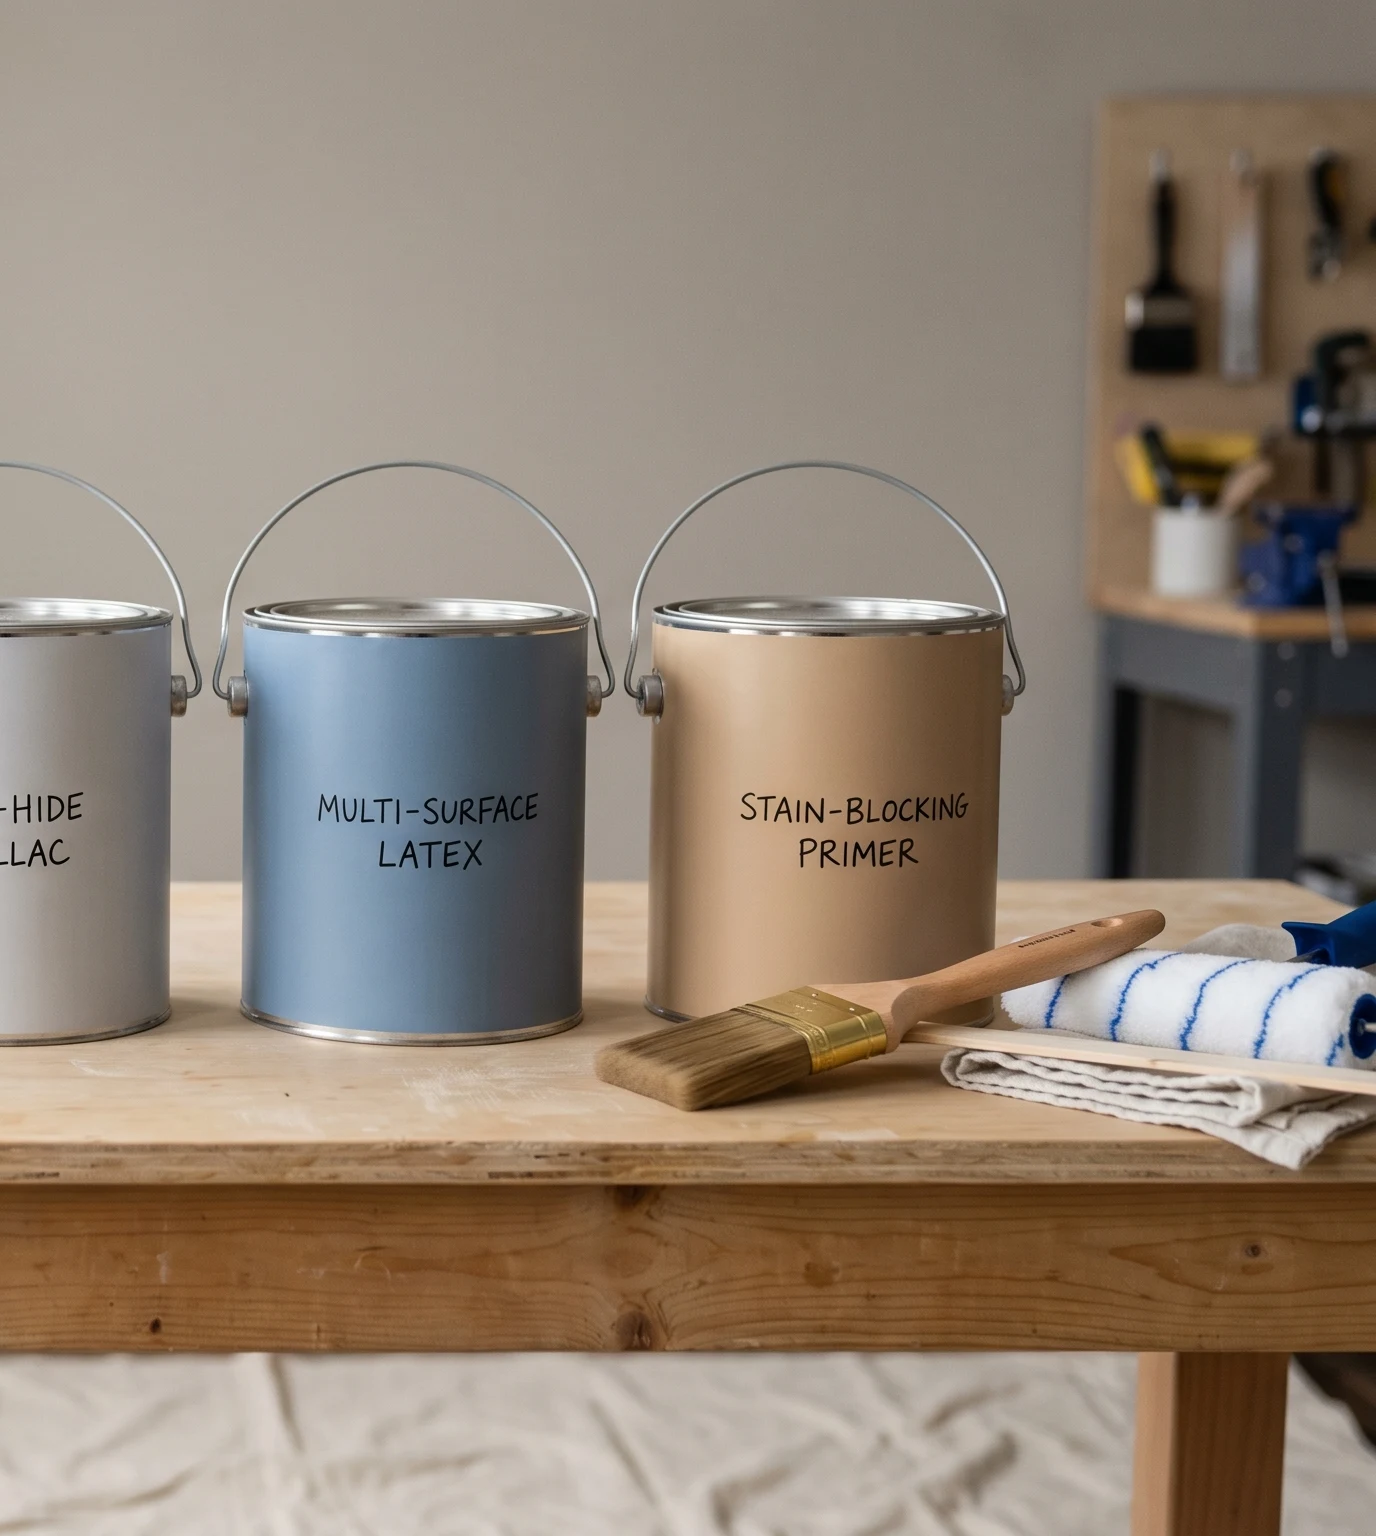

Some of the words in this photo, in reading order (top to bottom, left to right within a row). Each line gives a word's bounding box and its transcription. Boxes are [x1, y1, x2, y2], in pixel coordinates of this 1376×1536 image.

[317, 793, 539, 825] MULTI-SURFACE
[740, 792, 969, 825] STAIN-BLOCKING
[378, 840, 483, 870] LATEX
[799, 838, 919, 868] PRIMER
